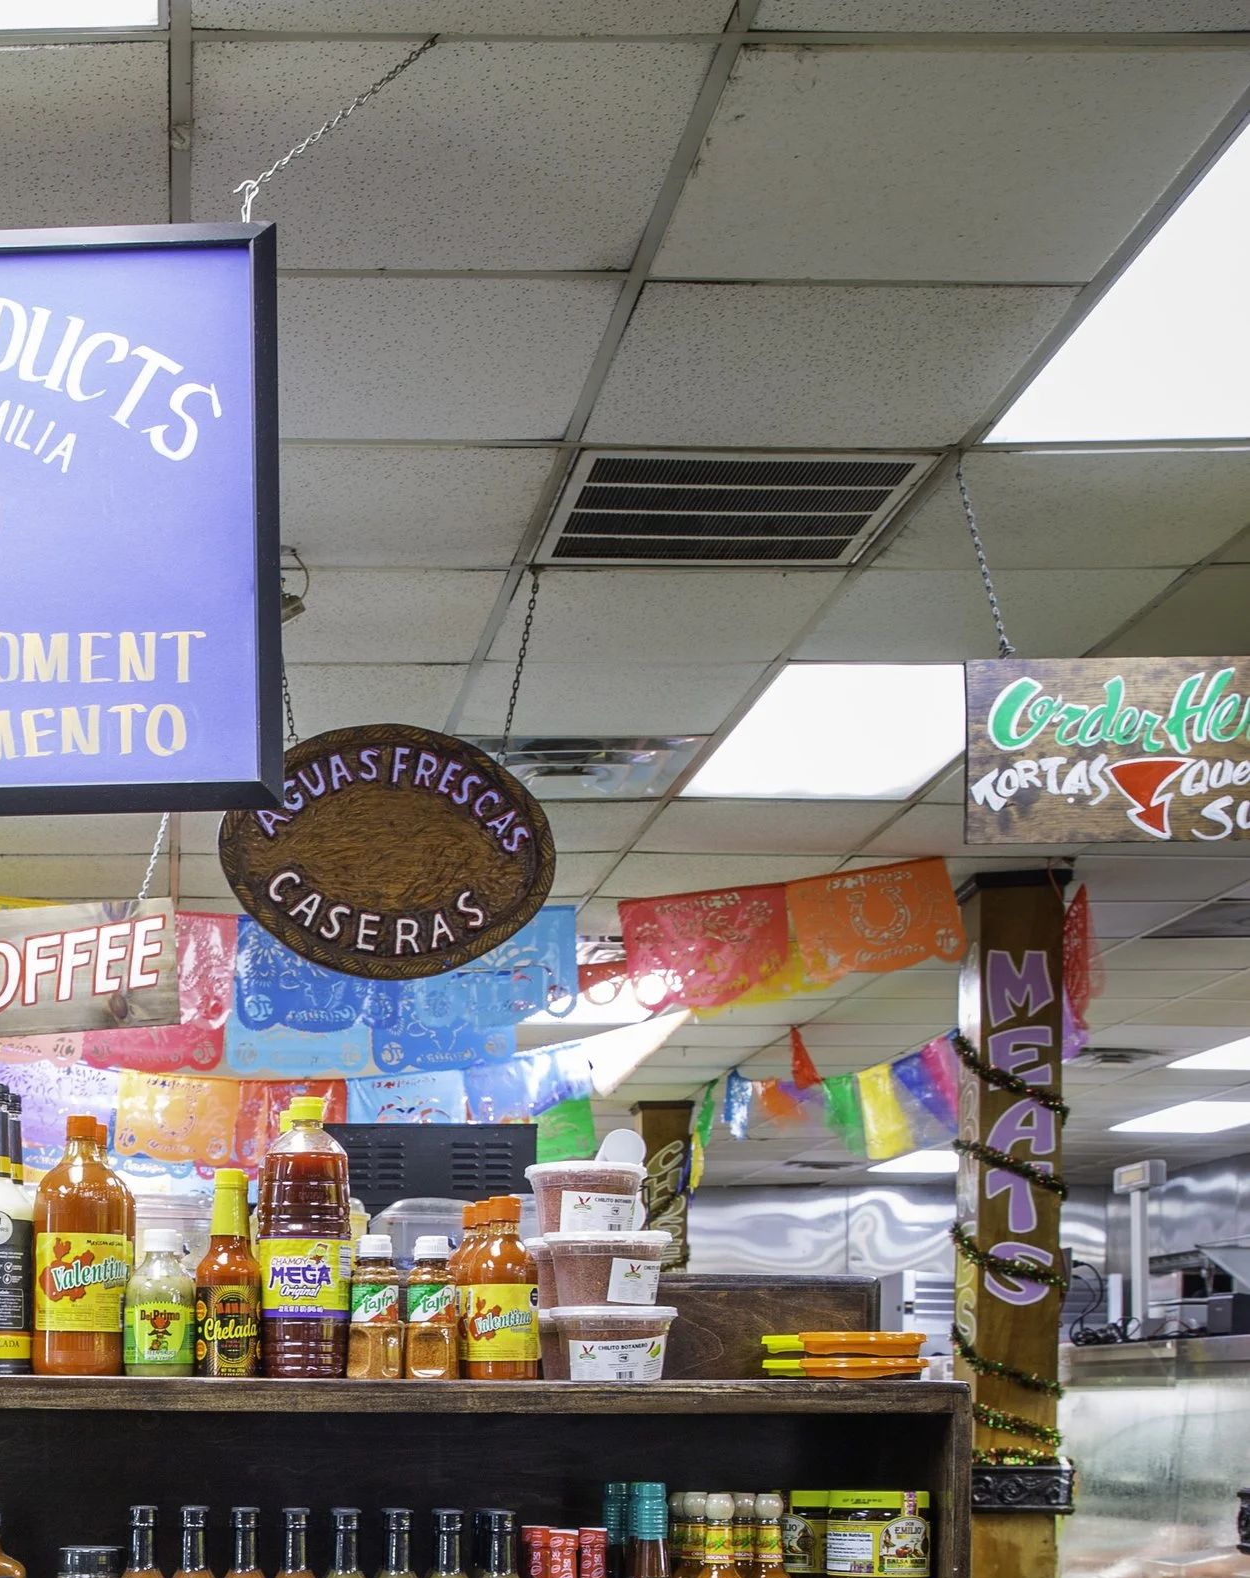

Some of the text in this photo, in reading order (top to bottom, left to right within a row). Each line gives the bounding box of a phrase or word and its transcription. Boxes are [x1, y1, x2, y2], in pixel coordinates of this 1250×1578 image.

[988, 667, 1250, 754] Order He
[257, 746, 531, 855] AGUAS FRESCAS
[970, 753, 1110, 812] TORTAS
[268, 869, 484, 956] CASERAS
[984, 949, 1056, 1306] MEATS
[269, 1265, 331, 1289] MEGA
[271, 1257, 308, 1265] CHAMOY
[280, 1284, 321, 1300] Original
[204, 1318, 257, 1341] Chelada
[475, 1309, 532, 1335] Valentina
